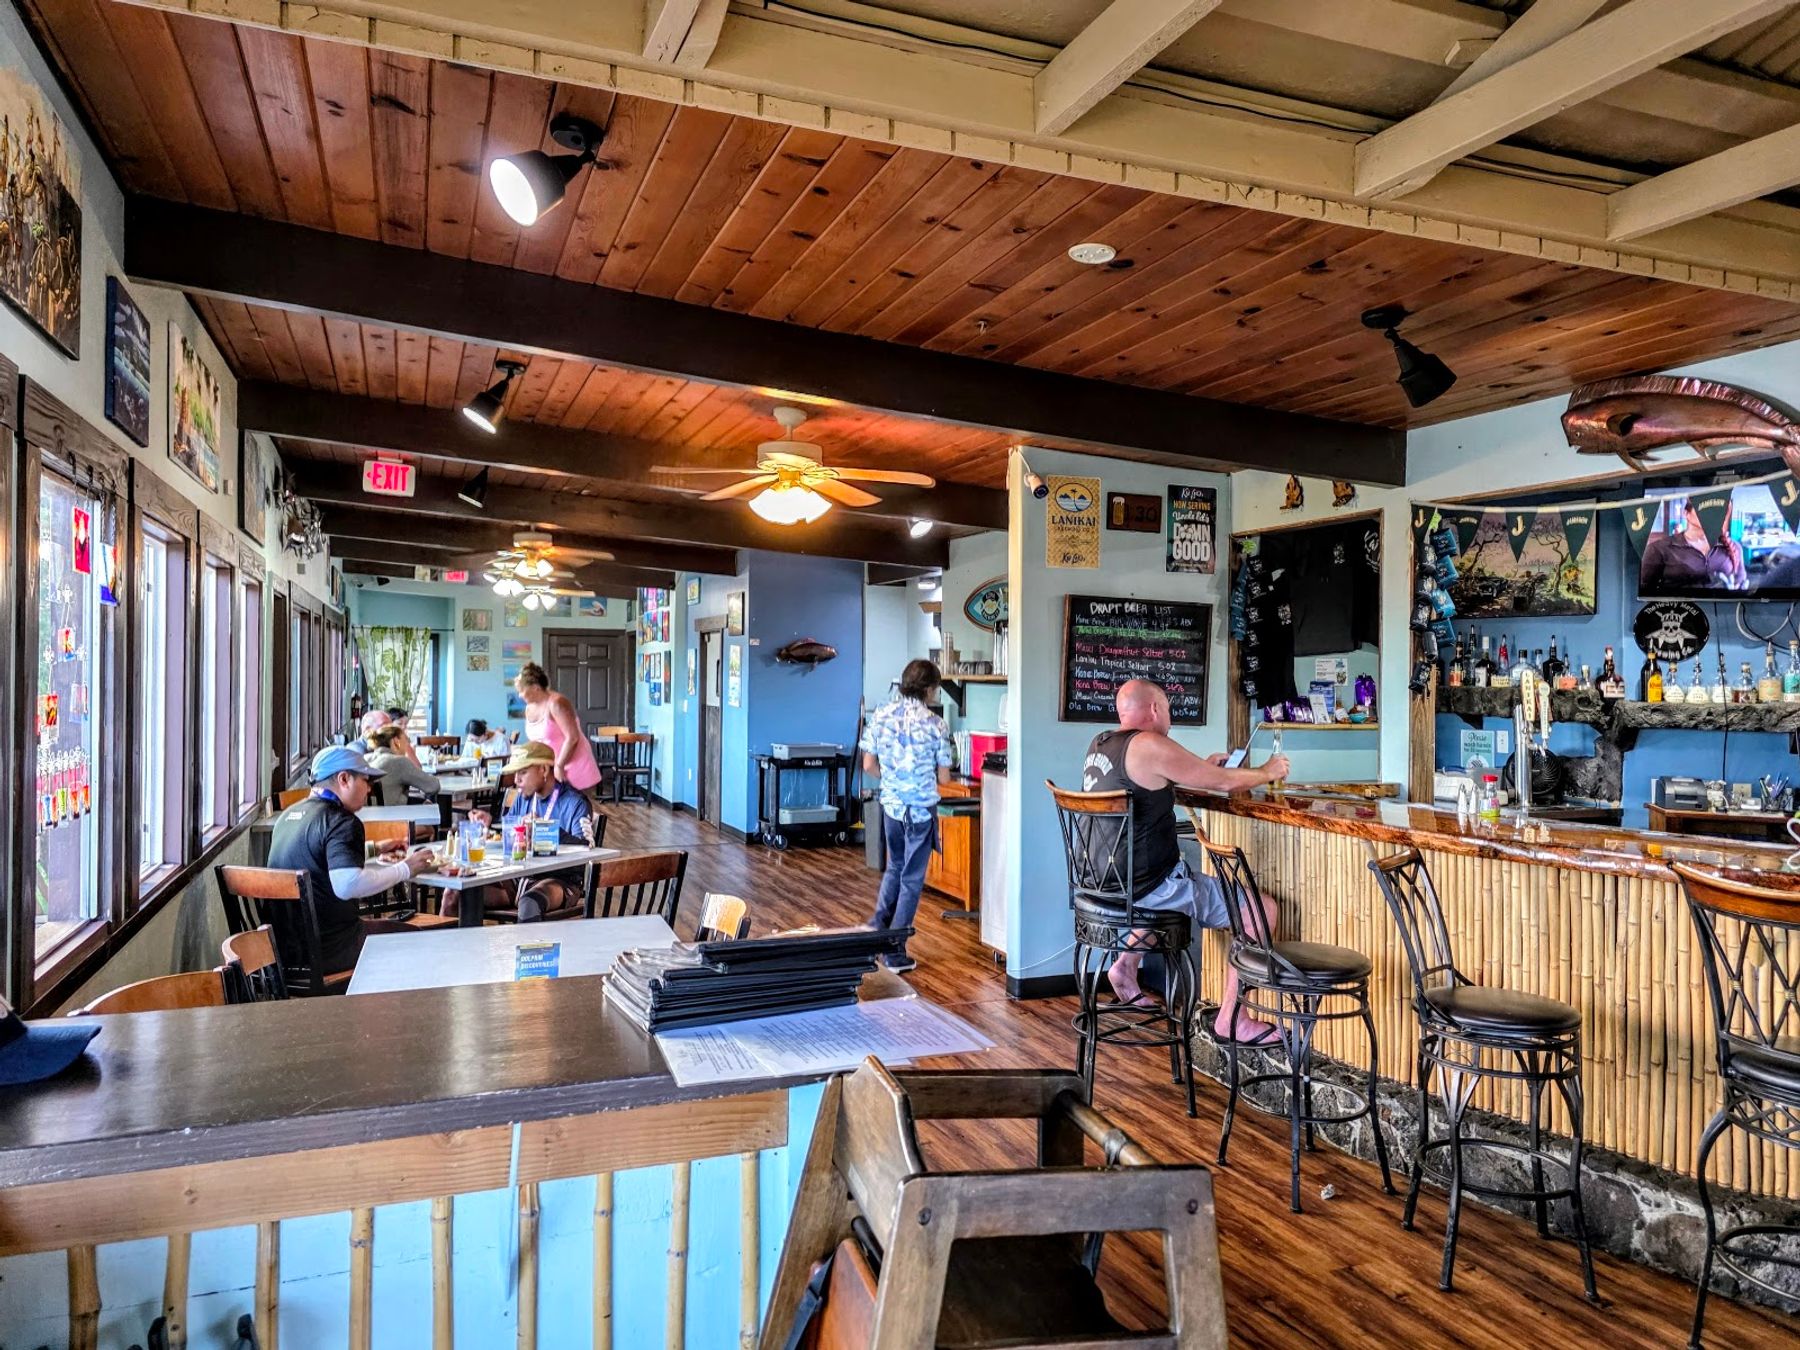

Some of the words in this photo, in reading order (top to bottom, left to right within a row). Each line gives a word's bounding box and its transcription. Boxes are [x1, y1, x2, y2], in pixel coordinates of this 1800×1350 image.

[372, 462, 410, 492] EXIT
[1051, 515, 1096, 527] LANIKAI
[1511, 515, 1526, 537] J
[1631, 507, 1648, 531] J
[1172, 541, 1211, 562] GOOD
[1123, 602, 1148, 615] BEER
[1154, 605, 1175, 615] LIST
[1644, 605, 1657, 615] The
[1655, 601, 1679, 609] Heavy
[1680, 602, 1700, 617] Metal
[1524, 672, 1534, 720] LANIKAI
